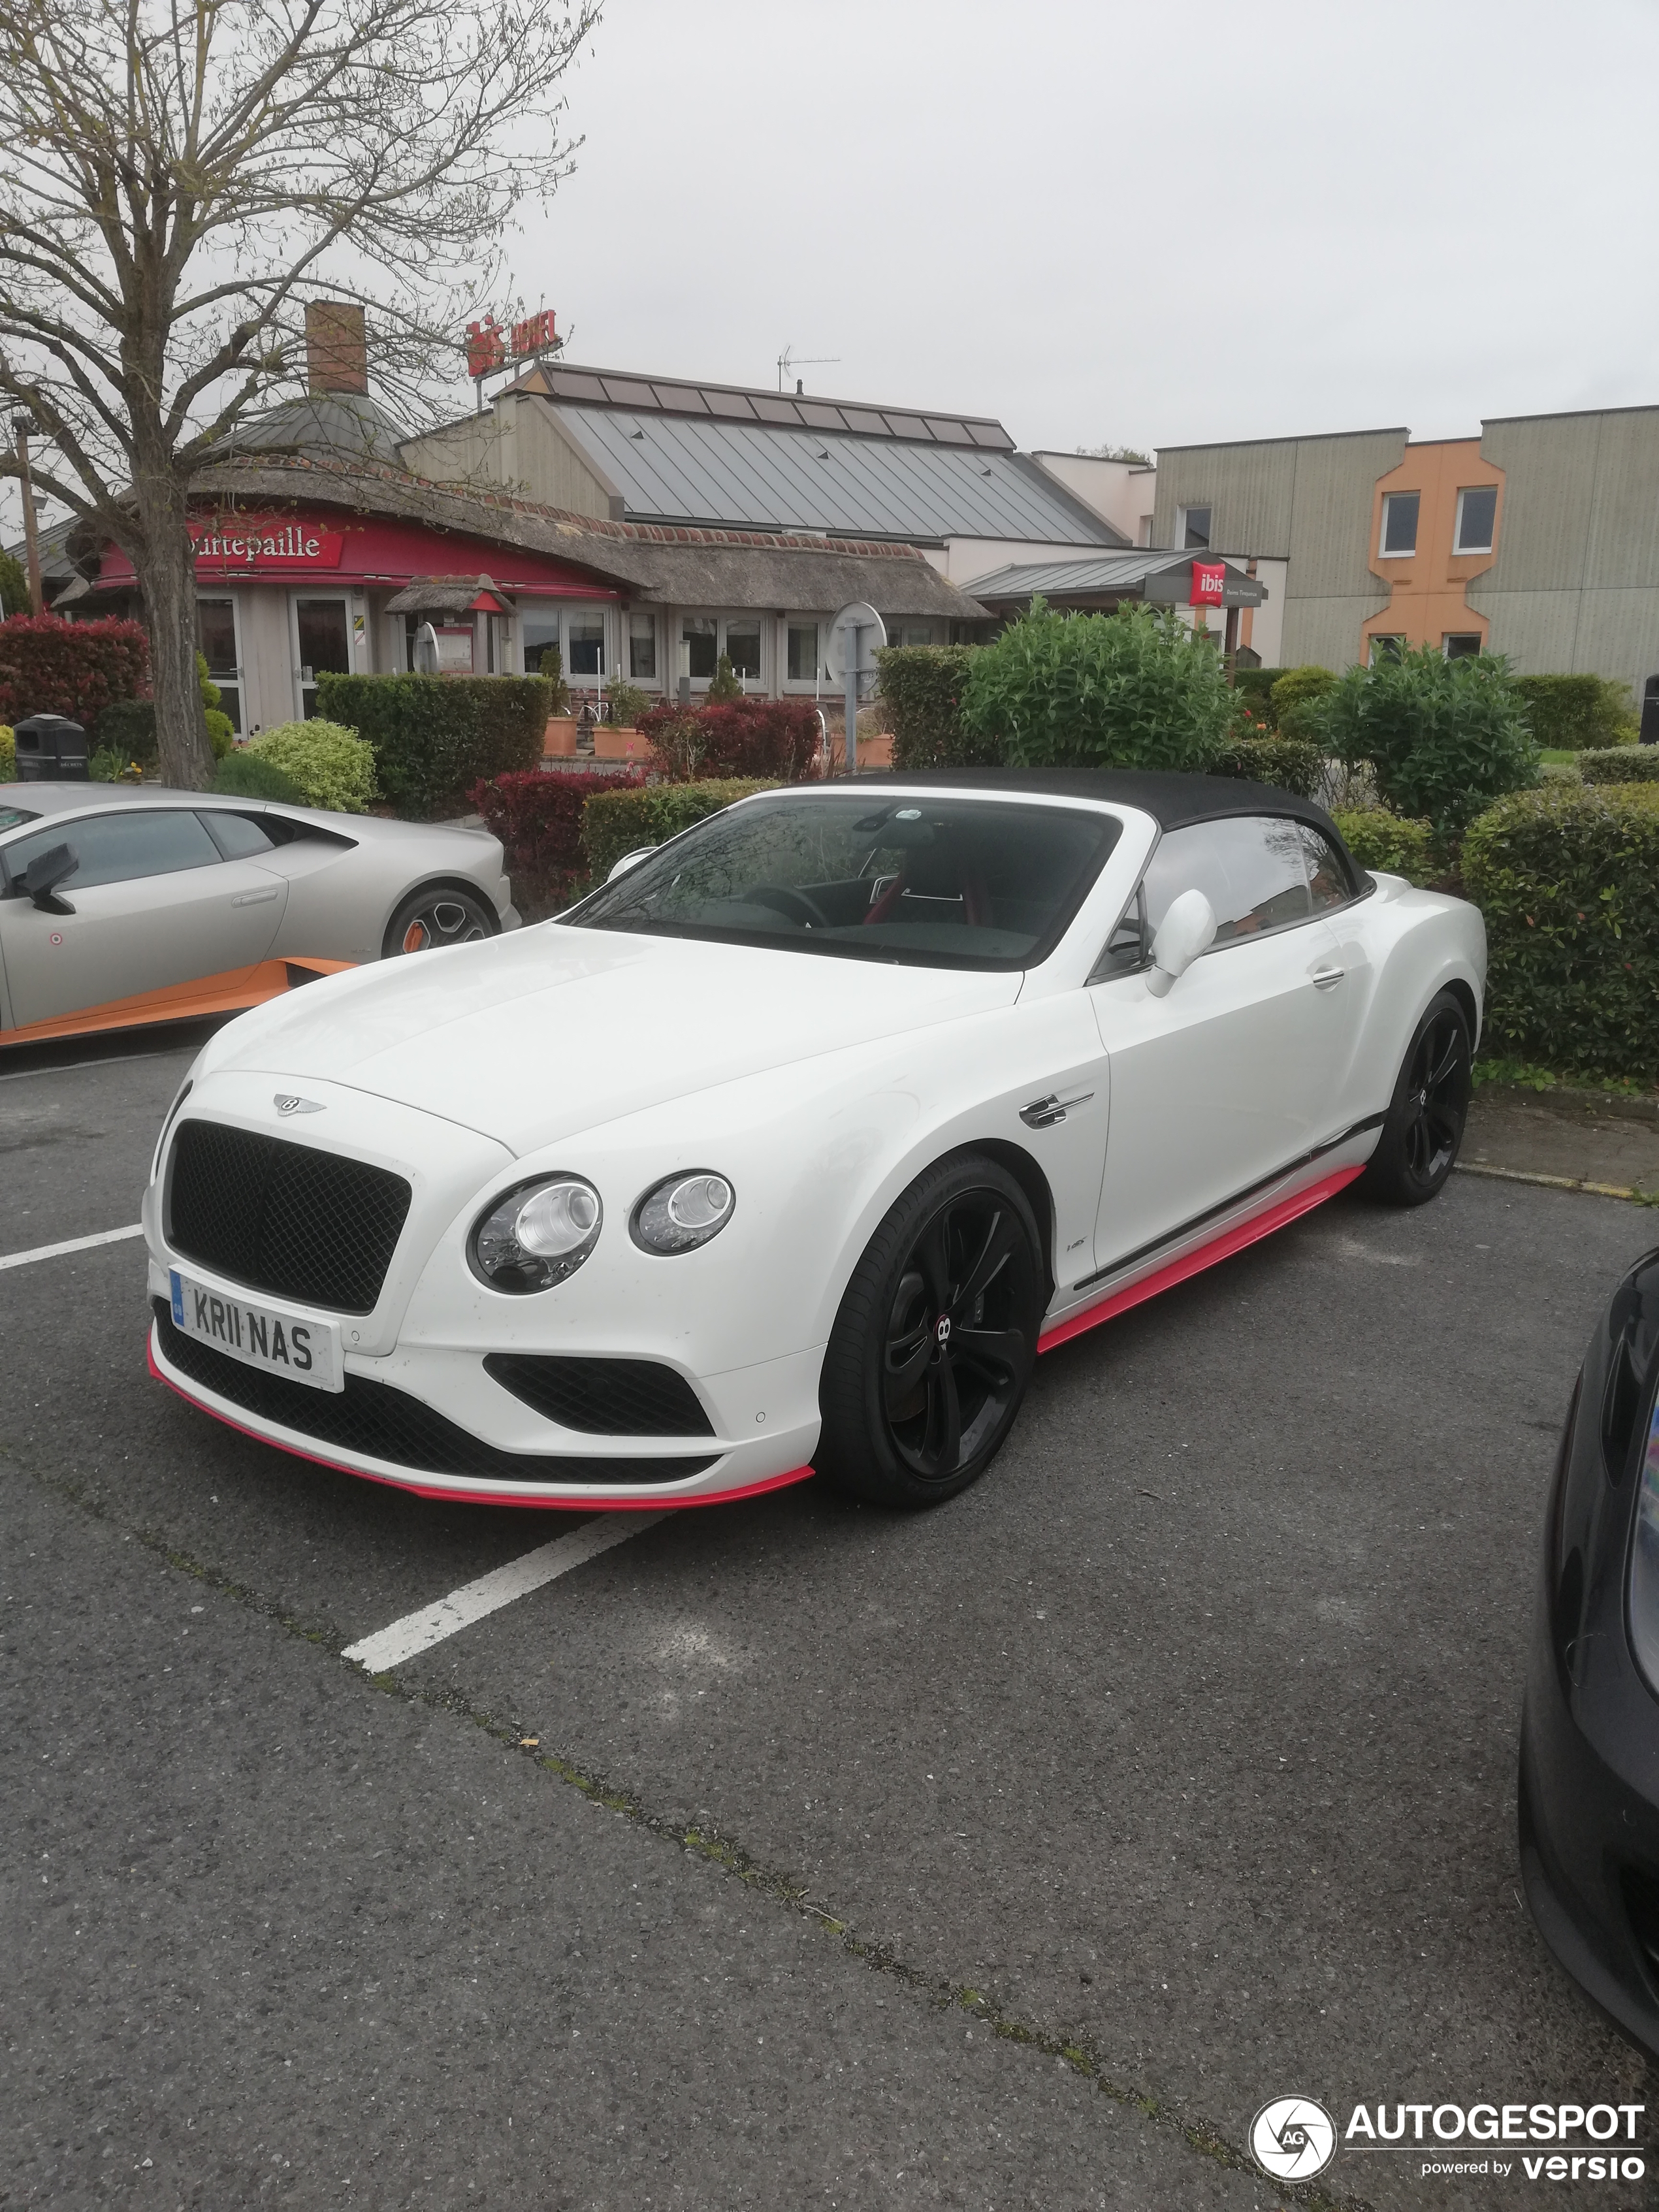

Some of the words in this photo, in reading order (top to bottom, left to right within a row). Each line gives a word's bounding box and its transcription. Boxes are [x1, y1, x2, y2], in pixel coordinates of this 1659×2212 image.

[511, 309, 555, 355] HOTEL
[191, 526, 320, 562] urtepaille
[1200, 573, 1223, 592] ibis
[174, 1302, 182, 1316] GB
[938, 1317, 951, 1342] B
